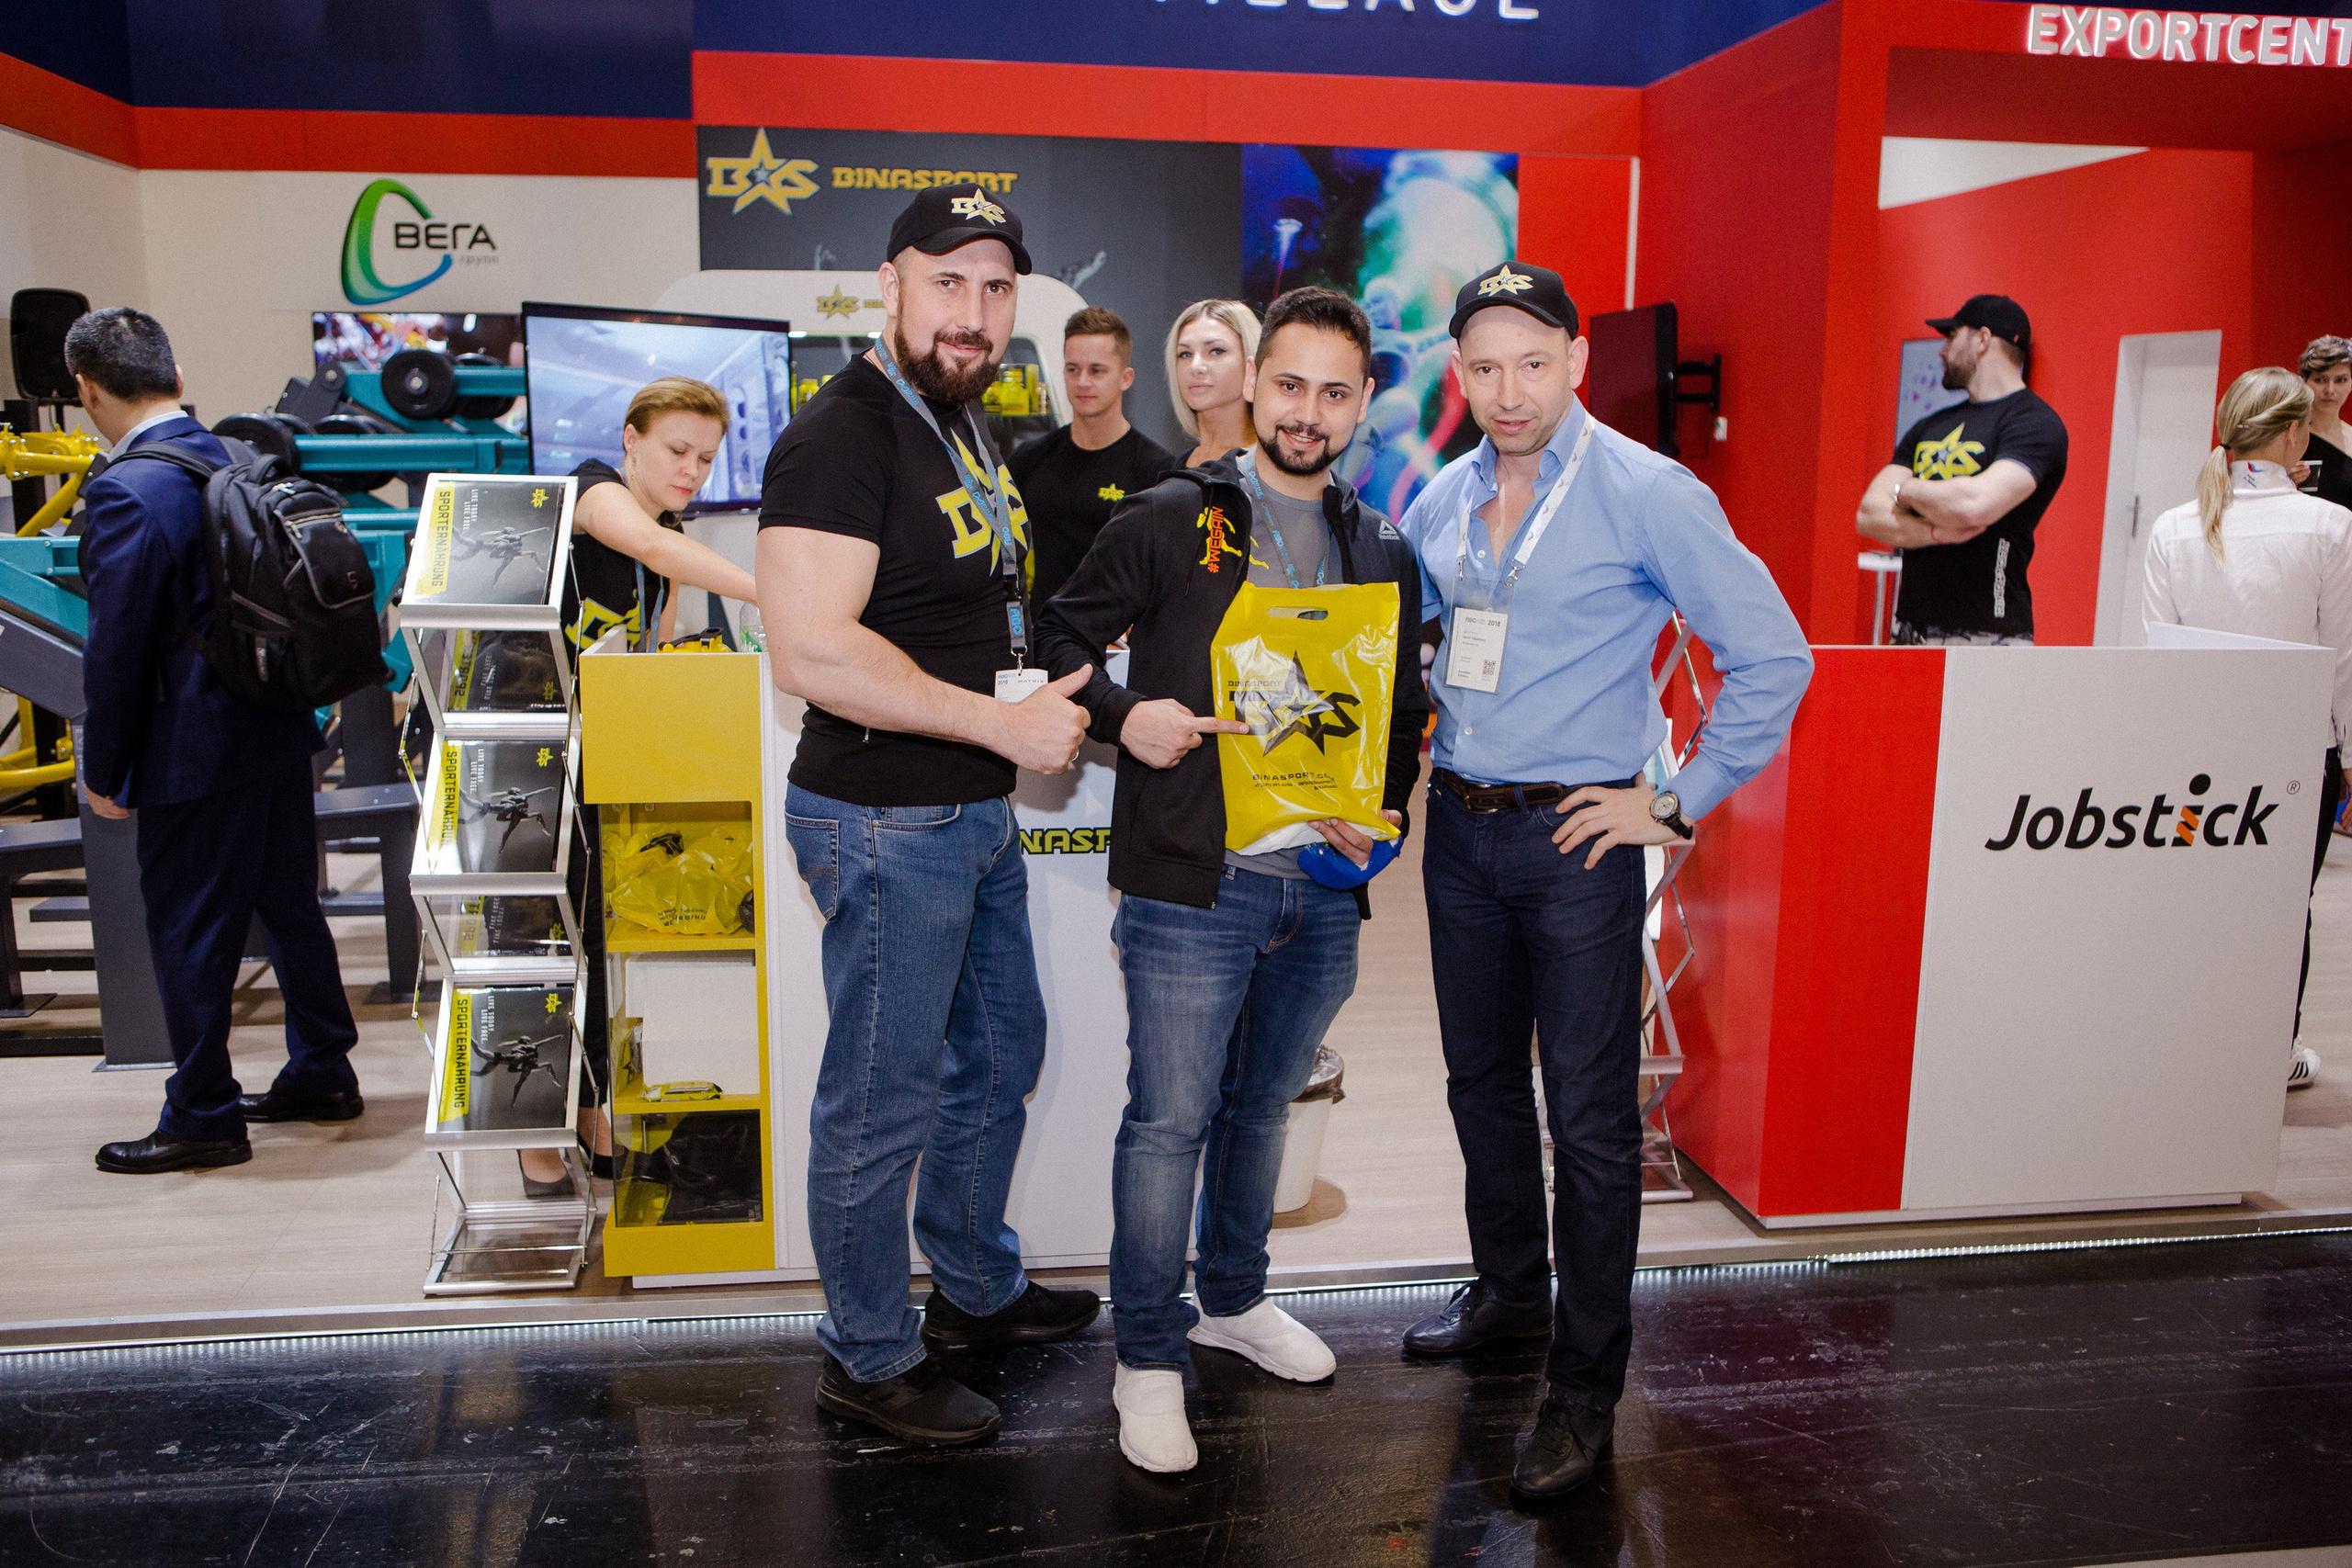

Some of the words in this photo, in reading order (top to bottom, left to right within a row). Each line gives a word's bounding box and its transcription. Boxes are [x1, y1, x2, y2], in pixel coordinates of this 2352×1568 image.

[832, 166, 1018, 194] BINASPORT
[393, 221, 497, 251] ВЕГА
[1207, 506, 1224, 573] #WEGAIN
[1010, 607, 1023, 636] FIBO
[1487, 619, 1501, 627] 2018
[1984, 773, 2279, 852] Jobstick
[454, 998, 469, 1108] SPORTERNÄHRUNG
